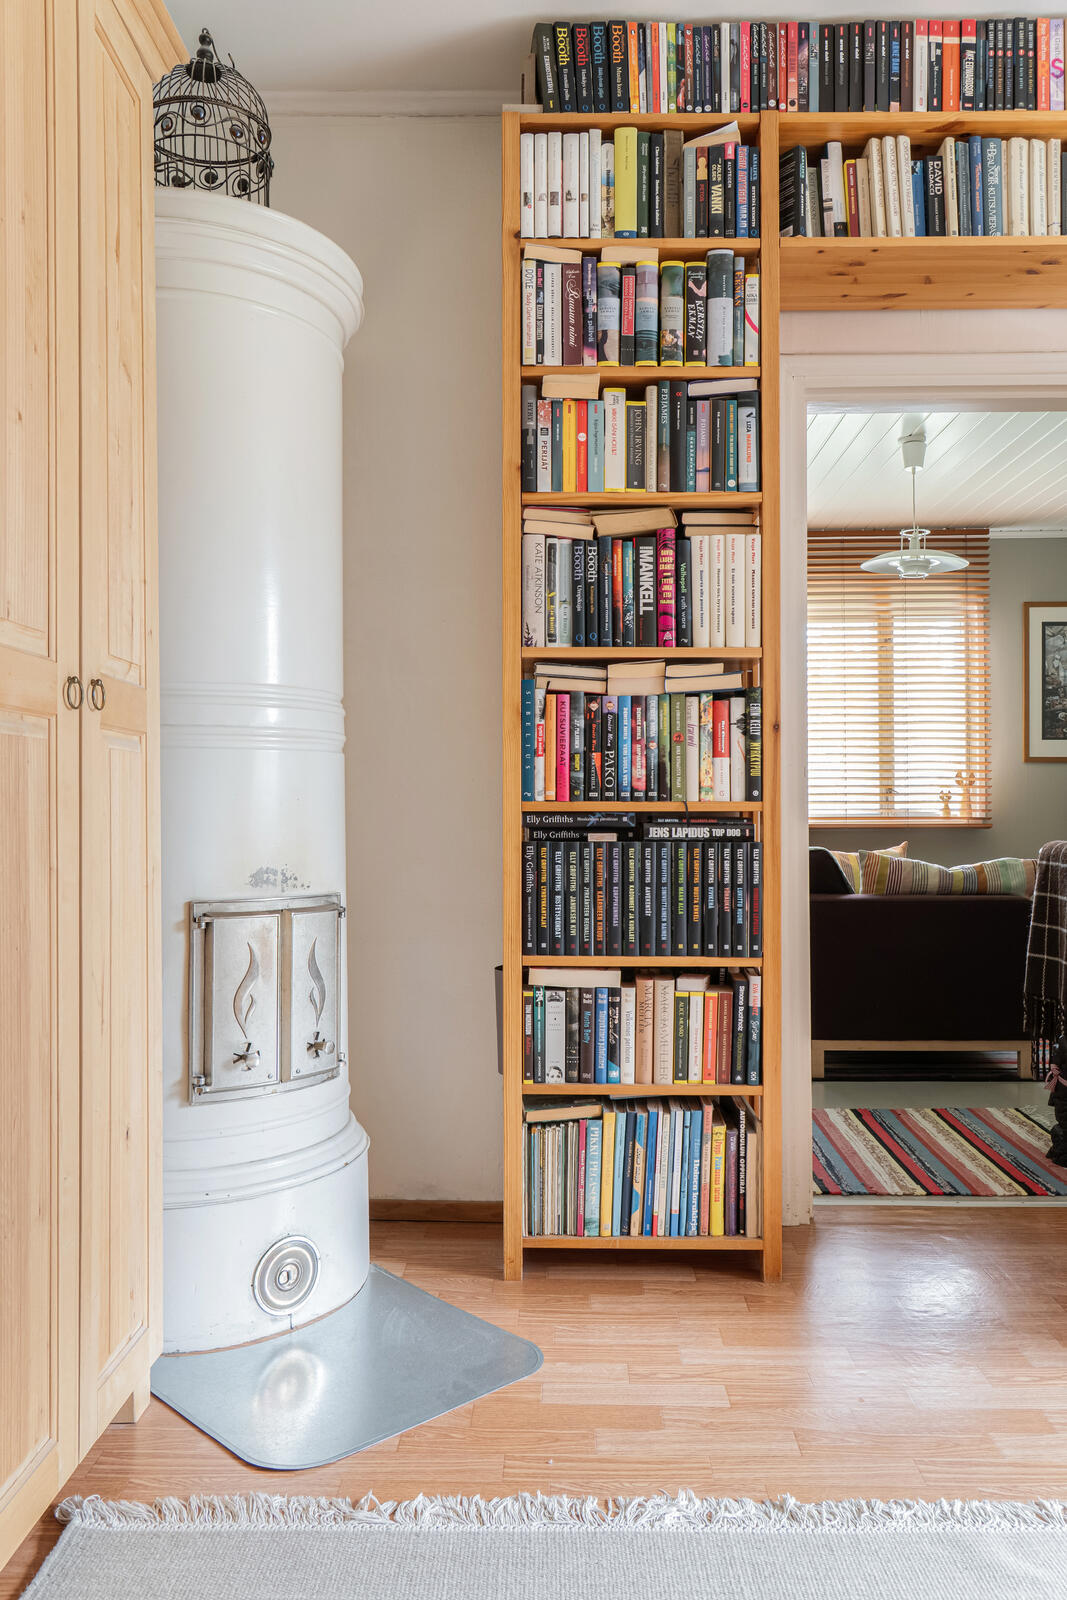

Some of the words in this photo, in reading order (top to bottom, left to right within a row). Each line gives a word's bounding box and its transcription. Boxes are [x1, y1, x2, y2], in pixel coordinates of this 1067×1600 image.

[556, 27, 570, 66] Booth
[576, 28, 589, 66] Booth
[593, 26, 605, 64] Booth
[612, 24, 624, 64] Booth
[934, 161, 942, 195] DAVID
[711, 184, 722, 214] VANKI
[525, 268, 533, 289] DOYLE
[569, 325, 577, 347] nimi
[687, 304, 696, 338] EKMAN
[695, 300, 704, 341] KERSTIN
[534, 542, 543, 564] KATE
[574, 546, 583, 580] Booth
[587, 546, 597, 582] Booth
[534, 567, 543, 614] ATKINSON
[640, 551, 654, 615] MANKELL
[750, 703, 760, 717] ERIN
[559, 700, 567, 767] KUTSUVIERAAT
[750, 719, 760, 736] KELLY
[604, 750, 615, 788] PAKO
[750, 742, 760, 776] MYRKKYPUU
[526, 815, 540, 825] Elly
[543, 815, 574, 823] Griffiths
[533, 831, 547, 840] Elly
[549, 830, 580, 839] Griffiths
[649, 827, 669, 838] JENS
[672, 827, 710, 838] LAPIDUS
[712, 828, 725, 837] TOP
[726, 828, 741, 837] DOG
[525, 845, 534, 859] Elly
[525, 861, 534, 893] Griffiths
[644, 985, 652, 1028] MARCIA
